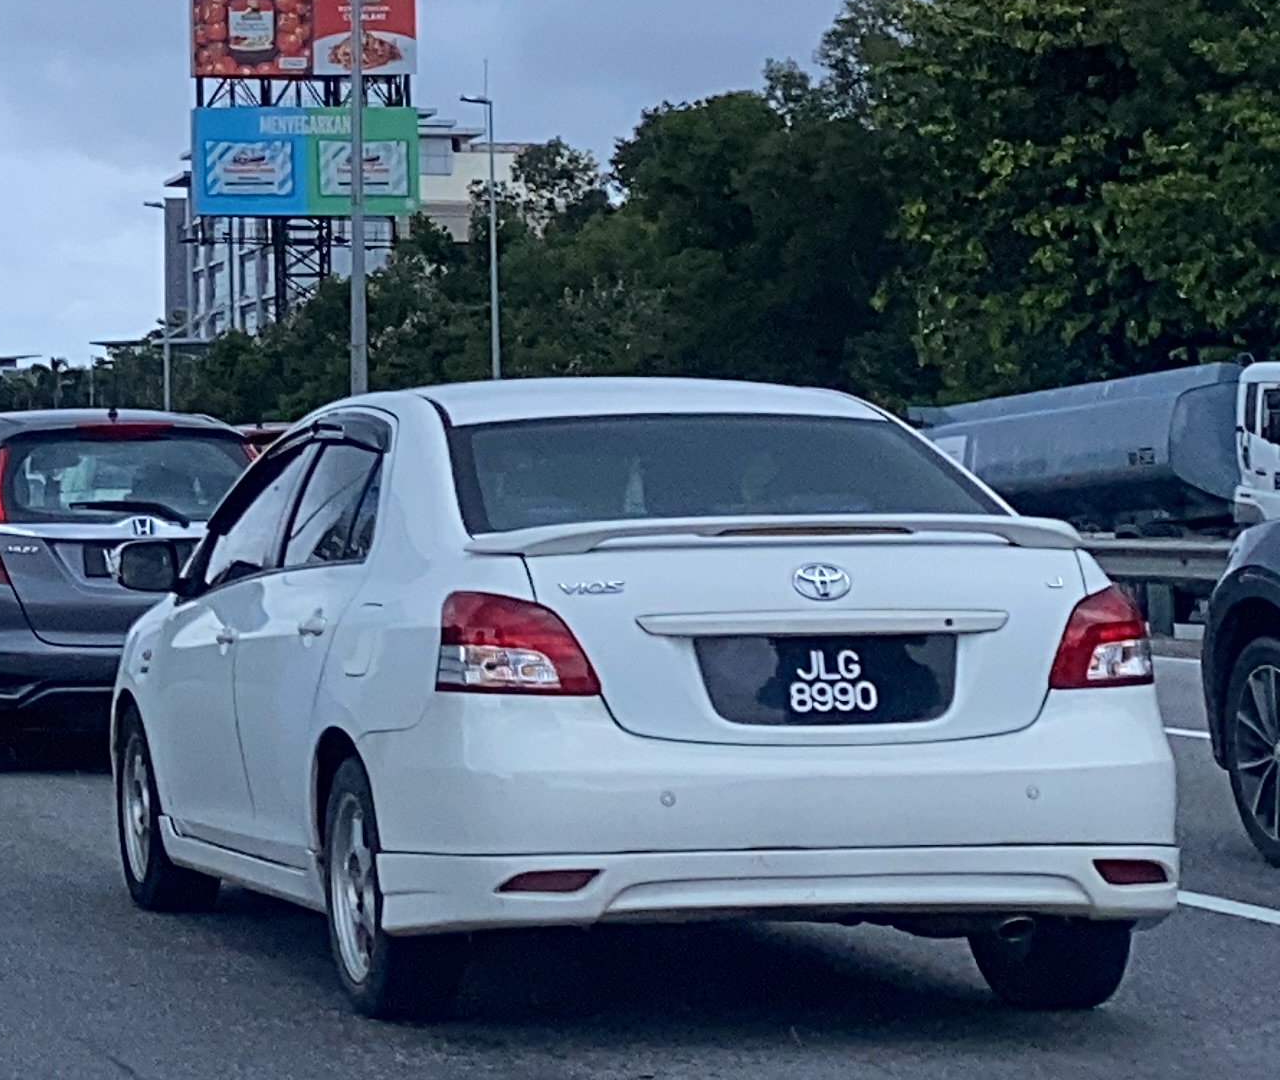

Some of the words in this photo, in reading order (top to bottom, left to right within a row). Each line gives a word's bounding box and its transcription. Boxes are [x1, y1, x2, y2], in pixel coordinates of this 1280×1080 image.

[558, 581, 627, 596] VIOS
[796, 650, 862, 681] JLG
[790, 681, 879, 713] 8990
